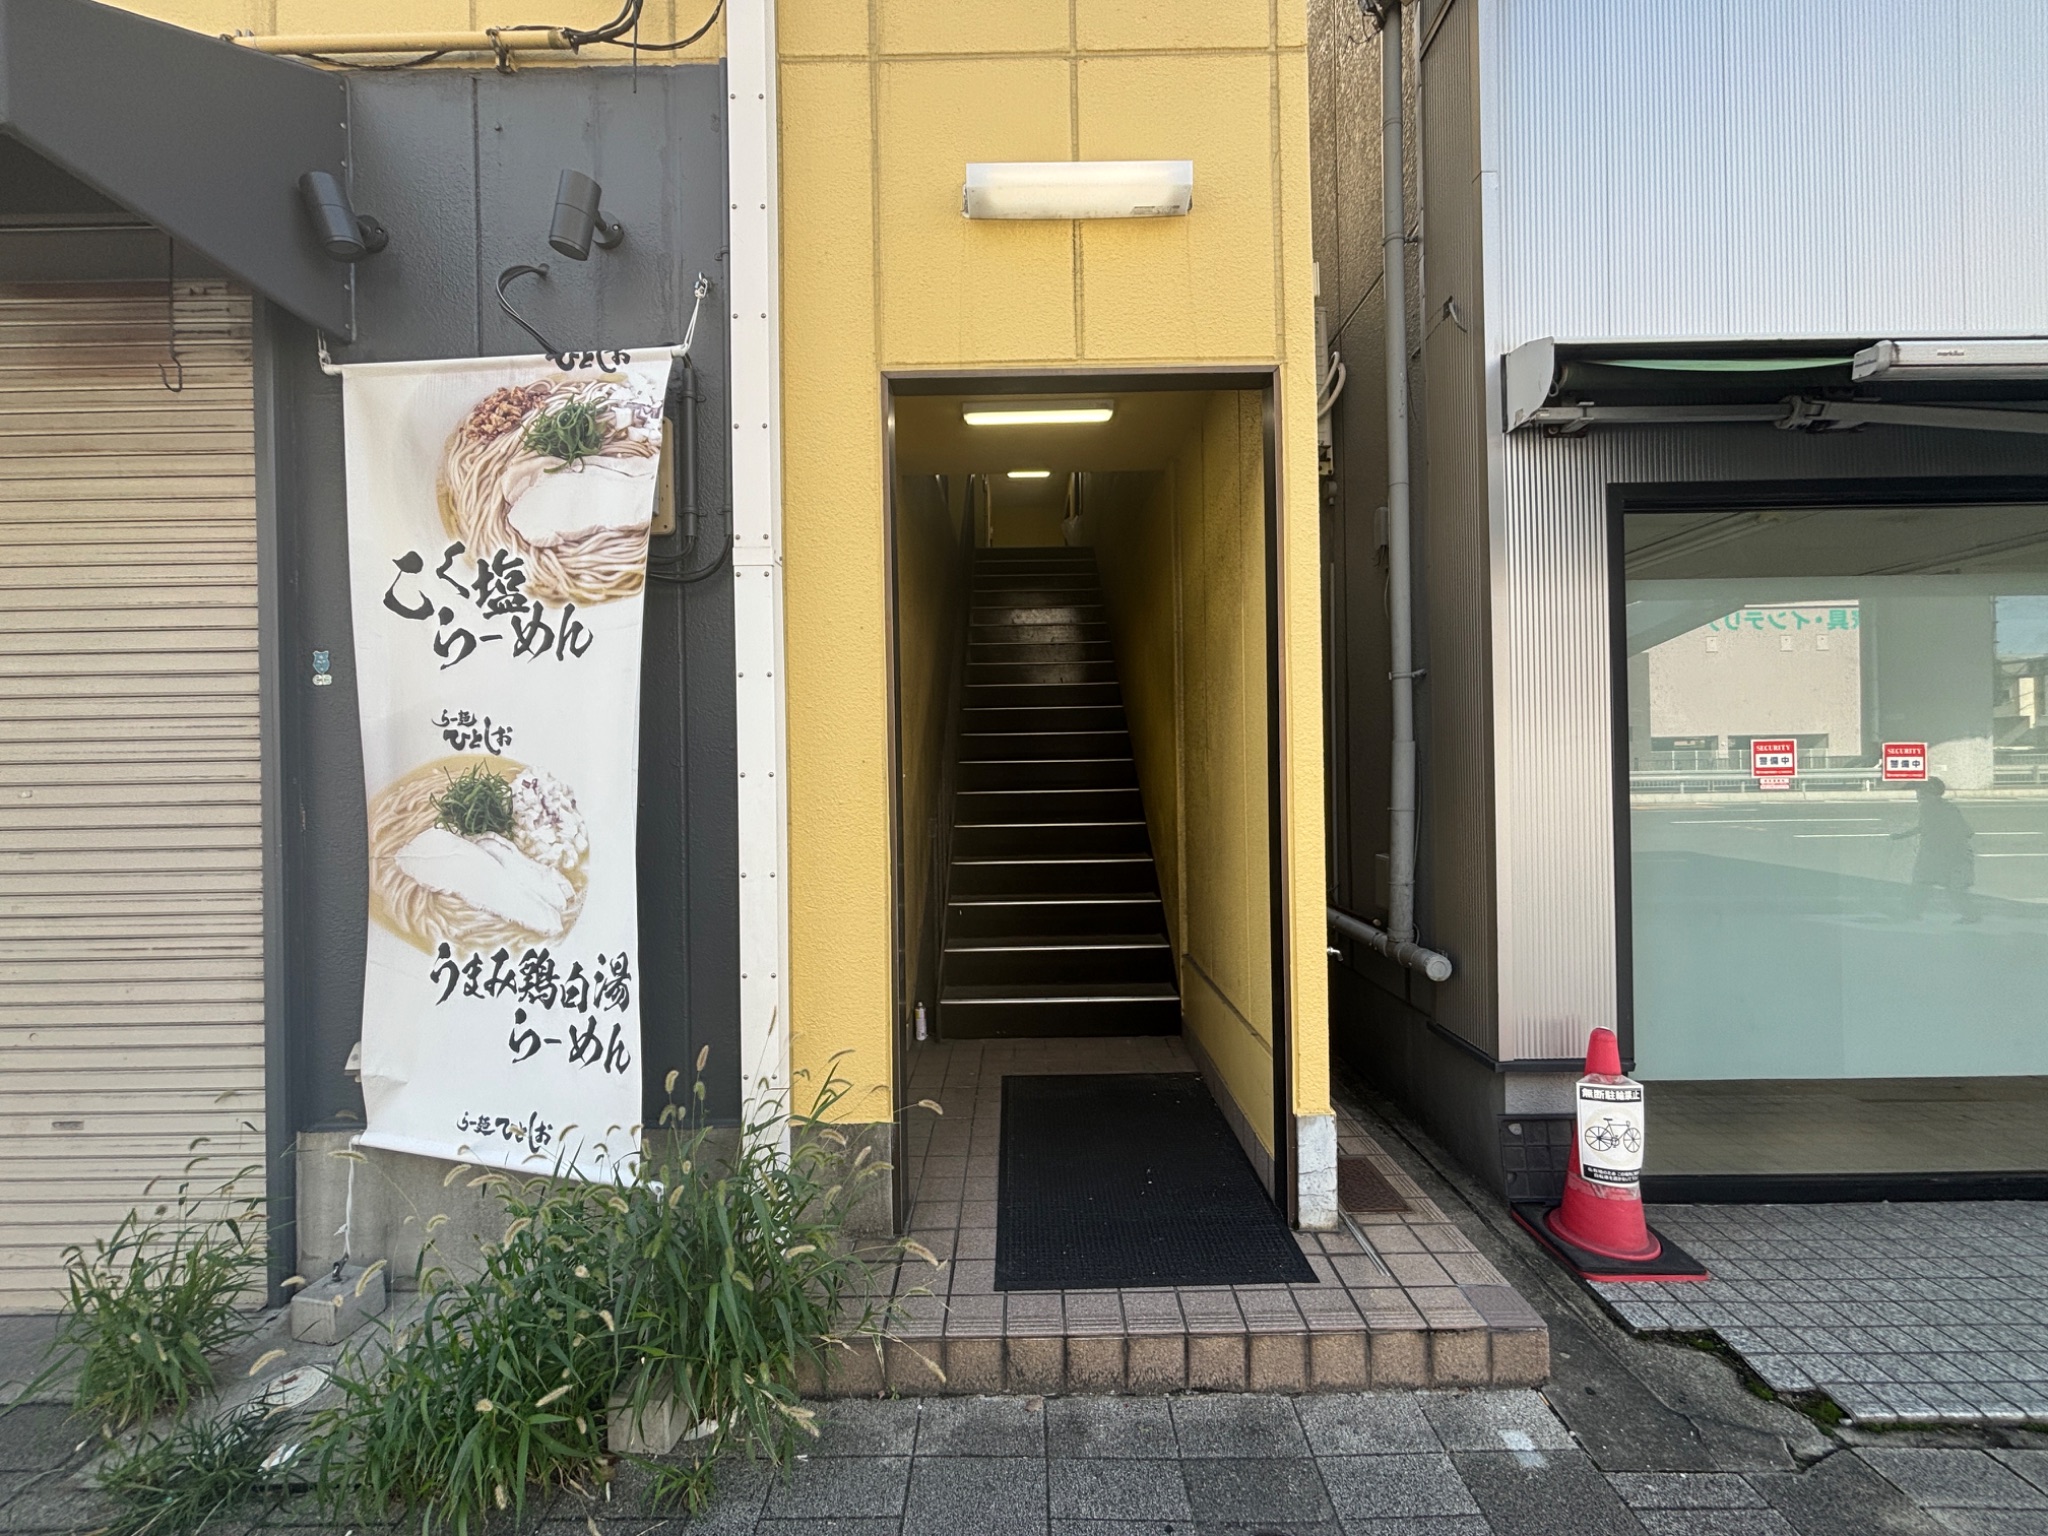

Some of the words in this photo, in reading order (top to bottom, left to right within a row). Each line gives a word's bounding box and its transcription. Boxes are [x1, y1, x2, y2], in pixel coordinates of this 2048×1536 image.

[383, 540, 531, 620] こく塩
[433, 602, 594, 670] らーめん
[431, 709, 477, 727] らー麺
[443, 716, 513, 756] ひとしお
[1756, 744, 1791, 752] SECURITY
[430, 943, 632, 1013] うまみ鶏白湯
[509, 1008, 632, 1075] らーめん
